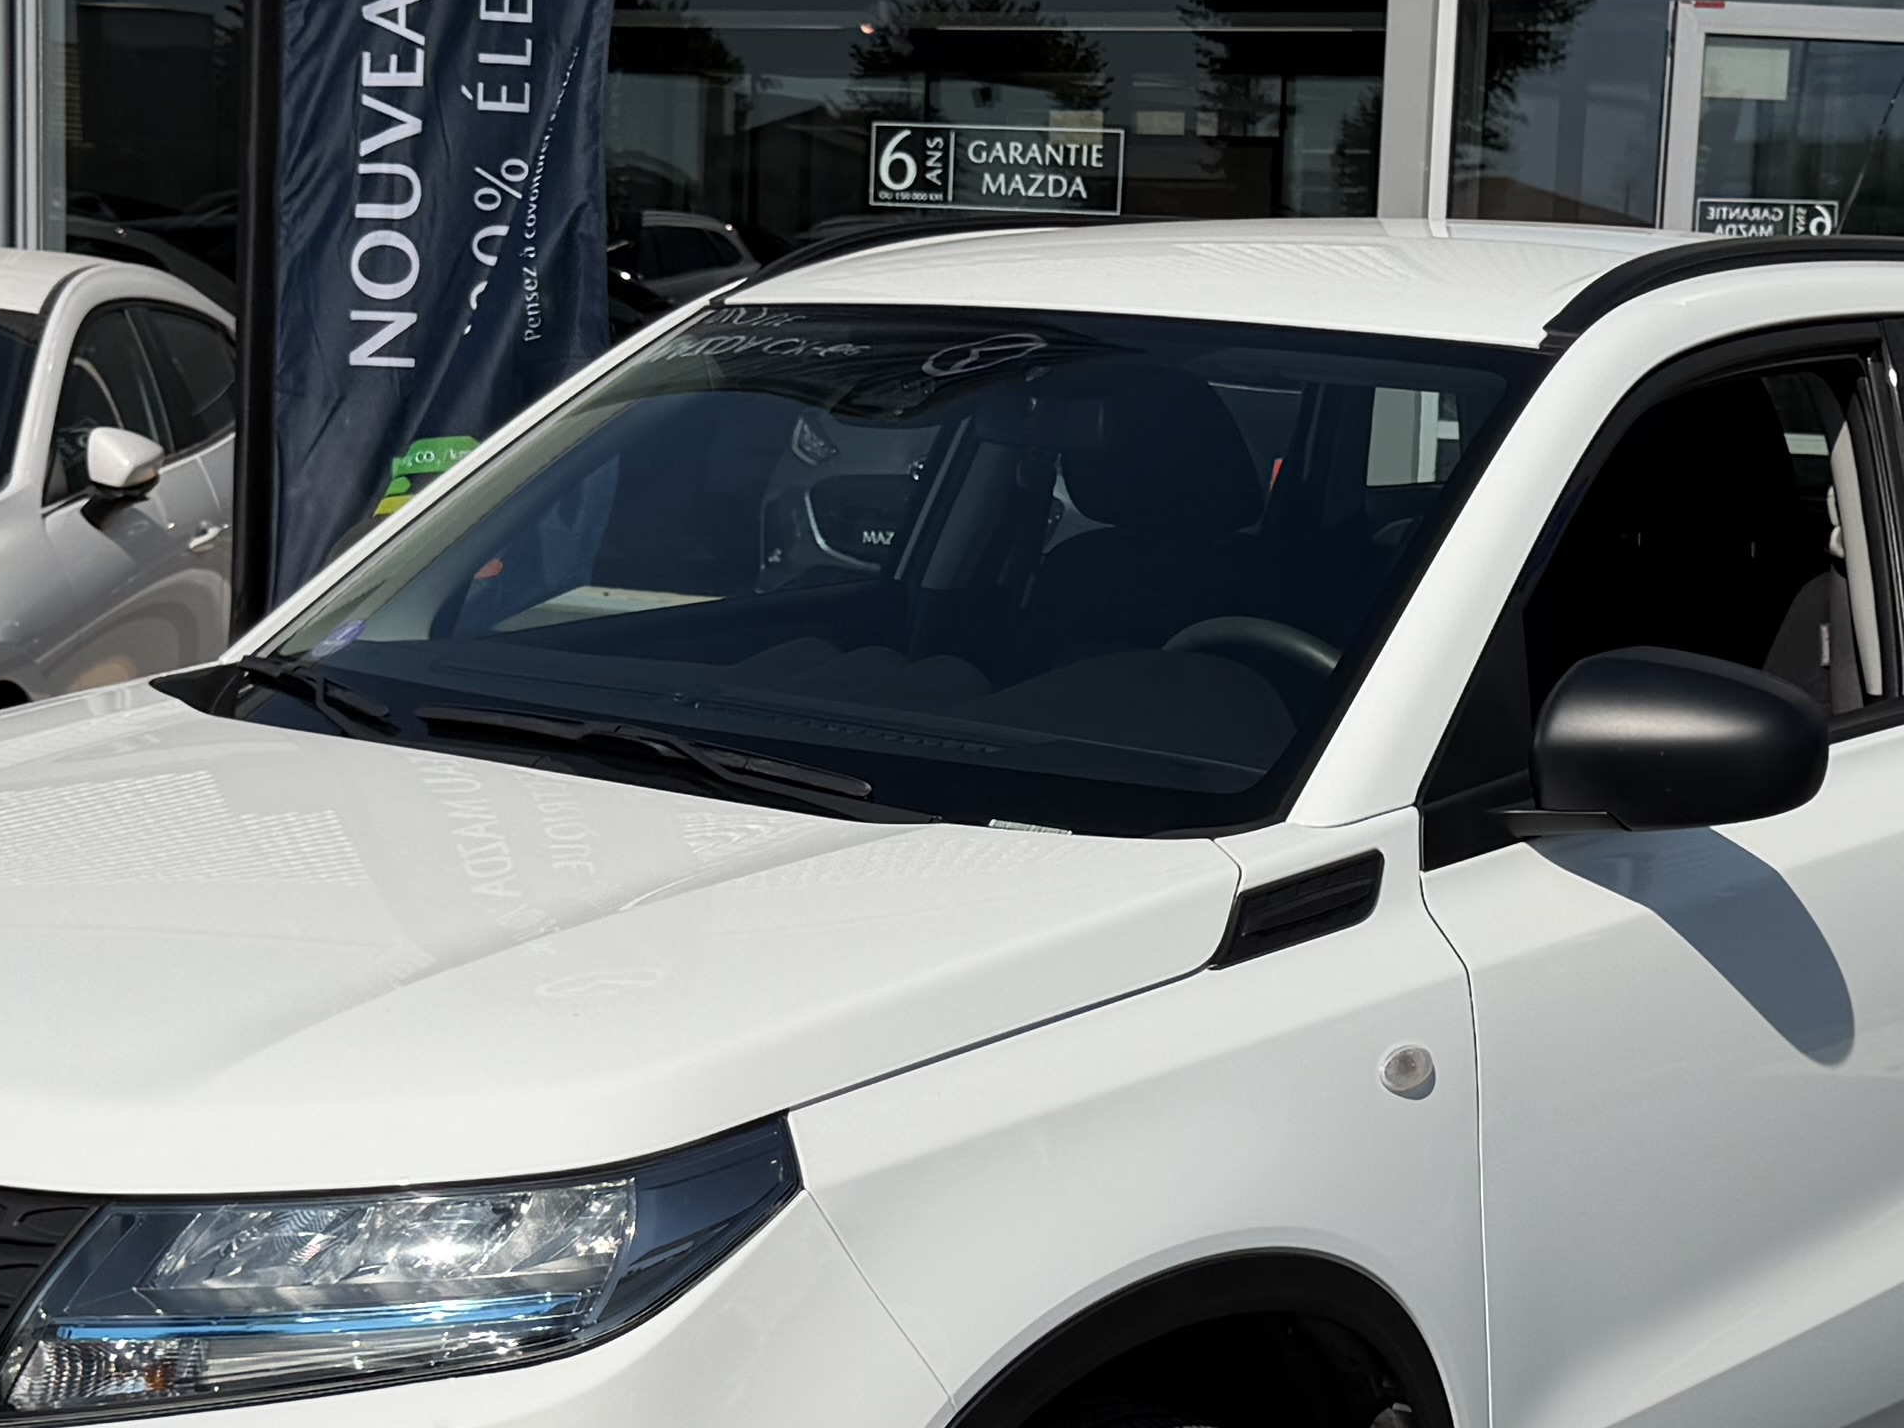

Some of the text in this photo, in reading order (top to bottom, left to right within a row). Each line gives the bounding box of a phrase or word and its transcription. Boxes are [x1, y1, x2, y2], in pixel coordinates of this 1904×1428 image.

[878, 129, 945, 191] 6 ANS
[967, 139, 1105, 168] GARANTIE
[981, 172, 1088, 200] MAZDA
[522, 265, 542, 342] Pensez
[862, 530, 895, 546] MAZ
